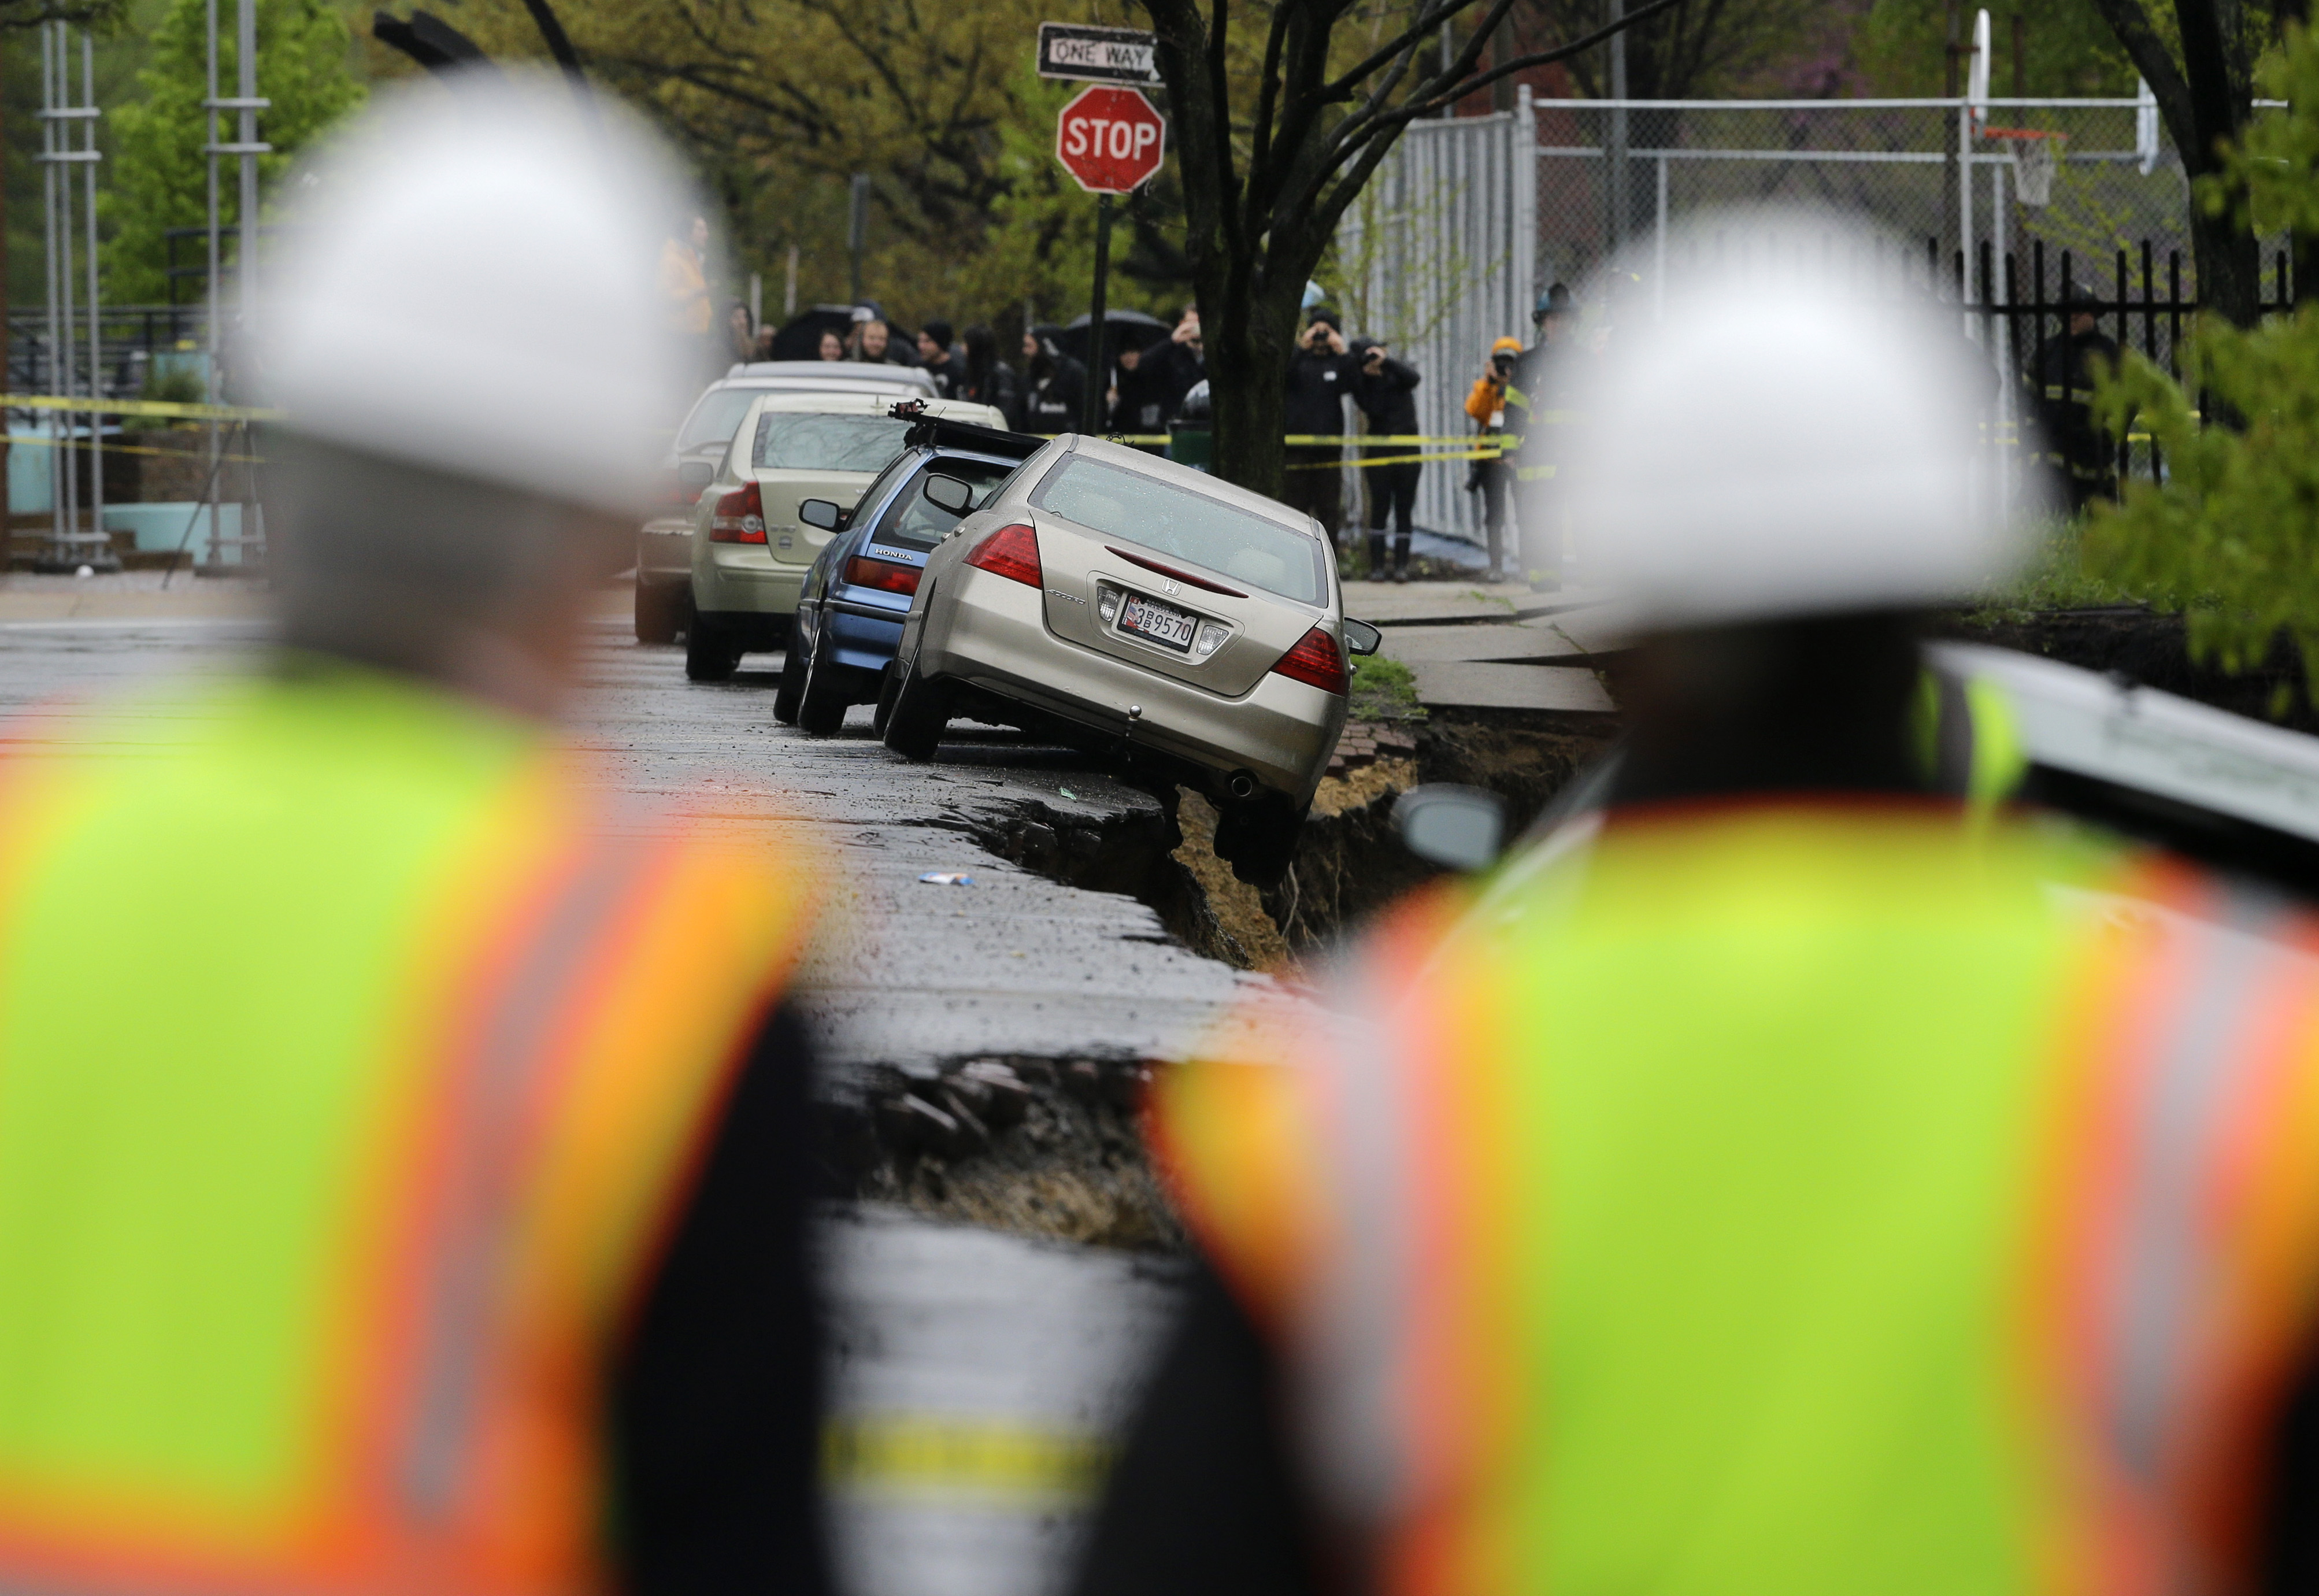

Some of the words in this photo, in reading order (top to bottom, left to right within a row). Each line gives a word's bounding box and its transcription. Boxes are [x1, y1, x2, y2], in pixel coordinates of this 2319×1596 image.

[1056, 42, 1096, 63] ONE
[1105, 46, 1147, 67] WAY
[1065, 117, 1157, 161] STOP
[875, 548, 913, 561] HONDA
[1045, 589, 1086, 605] ACCORD
